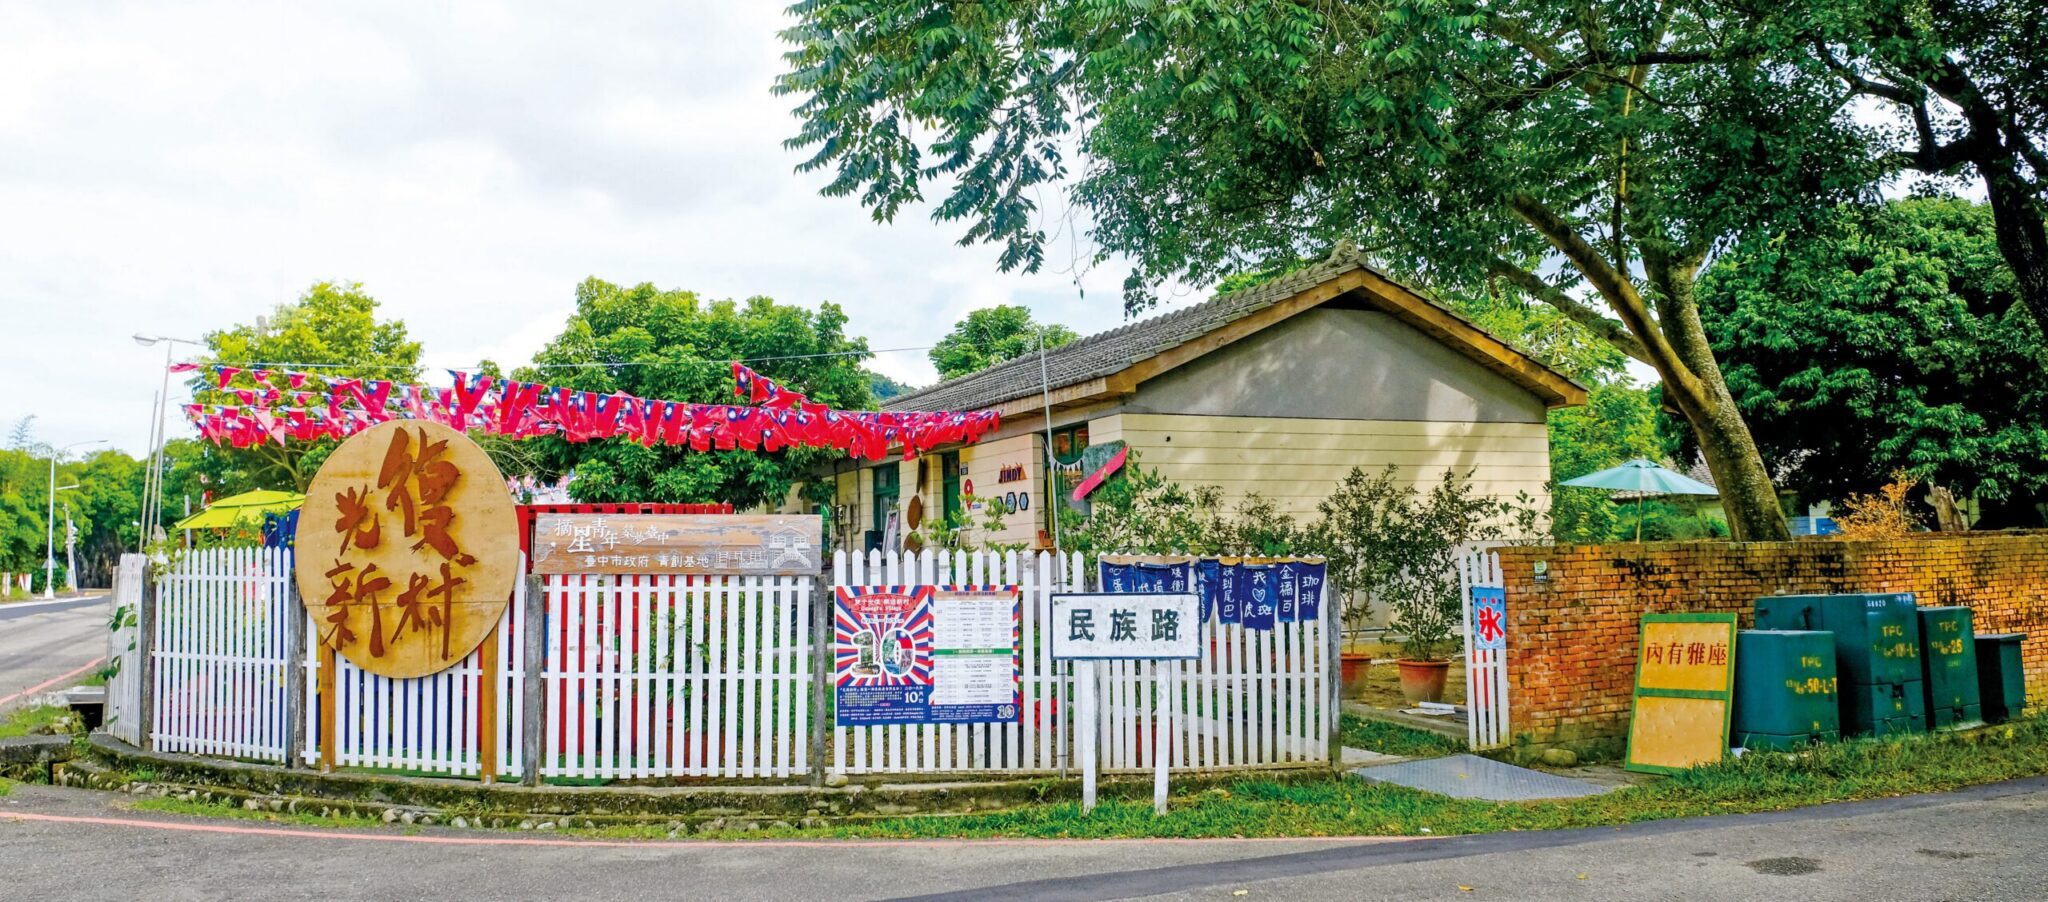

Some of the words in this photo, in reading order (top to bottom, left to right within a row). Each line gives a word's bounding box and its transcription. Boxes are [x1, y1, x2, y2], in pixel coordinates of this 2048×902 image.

[554, 517, 621, 553] 摘星青年
[584, 554, 649, 568] 臺中市政府
[658, 554, 709, 569] 青創基地
[1301, 574, 1320, 606] 珈琲
[1244, 602, 1273, 618] 虎斑
[1068, 608, 1180, 642] 民族路
[1881, 625, 1904, 638] TPC
[1938, 621, 1959, 632] TPC
[850, 627, 916, 677] 10
[1800, 656, 1823, 668] TPC
[904, 691, 918, 704] 10
